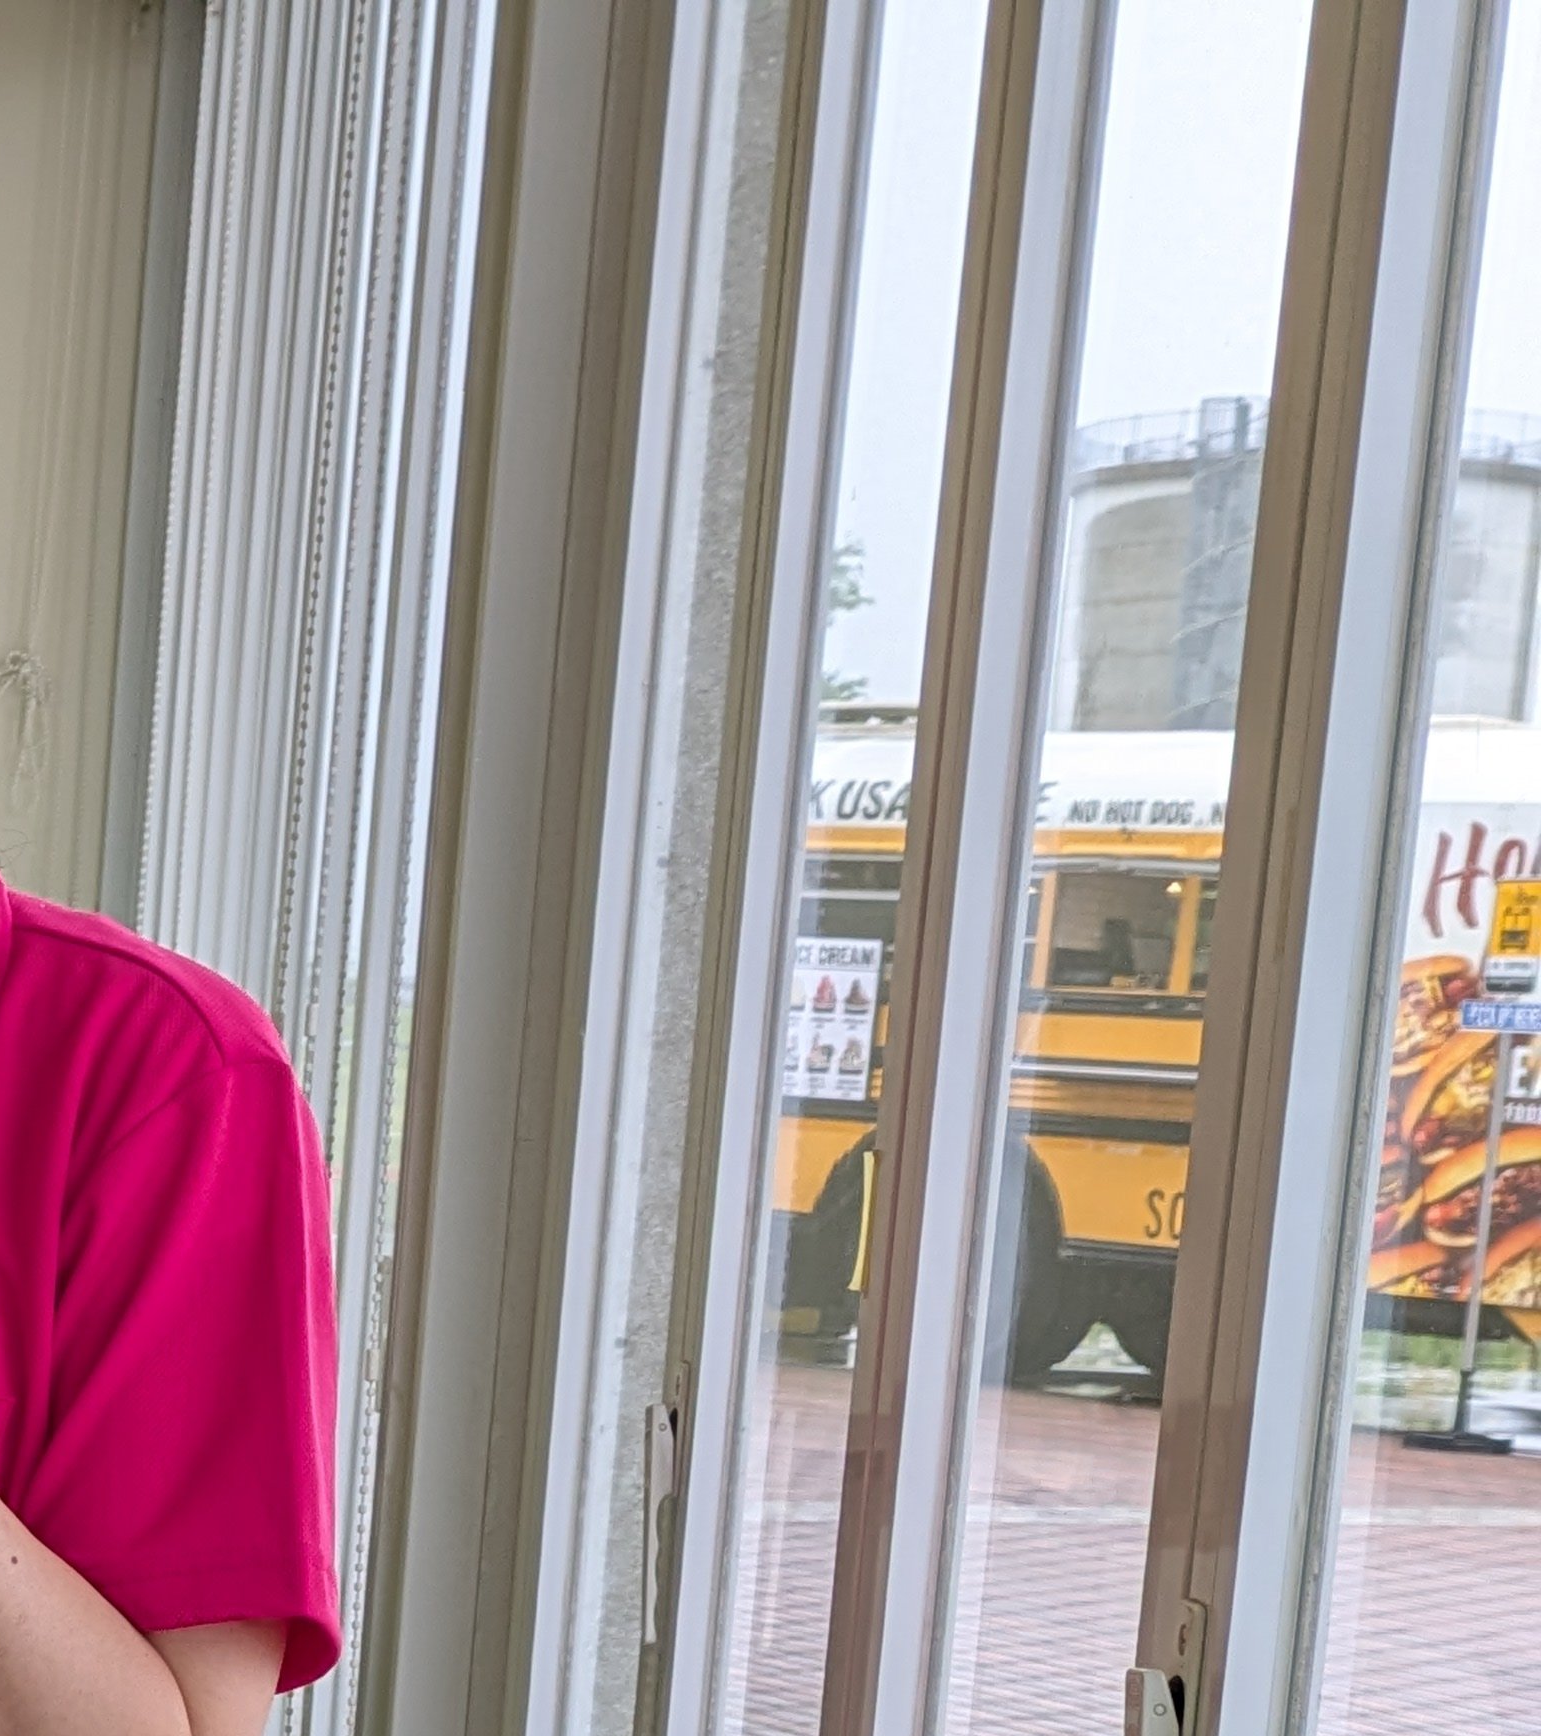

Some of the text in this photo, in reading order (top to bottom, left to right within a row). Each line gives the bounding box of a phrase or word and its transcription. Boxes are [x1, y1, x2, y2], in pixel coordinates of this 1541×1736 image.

[837, 779, 911, 819] USA
[1068, 799, 1101, 823] NO
[1104, 798, 1147, 824] HOT
